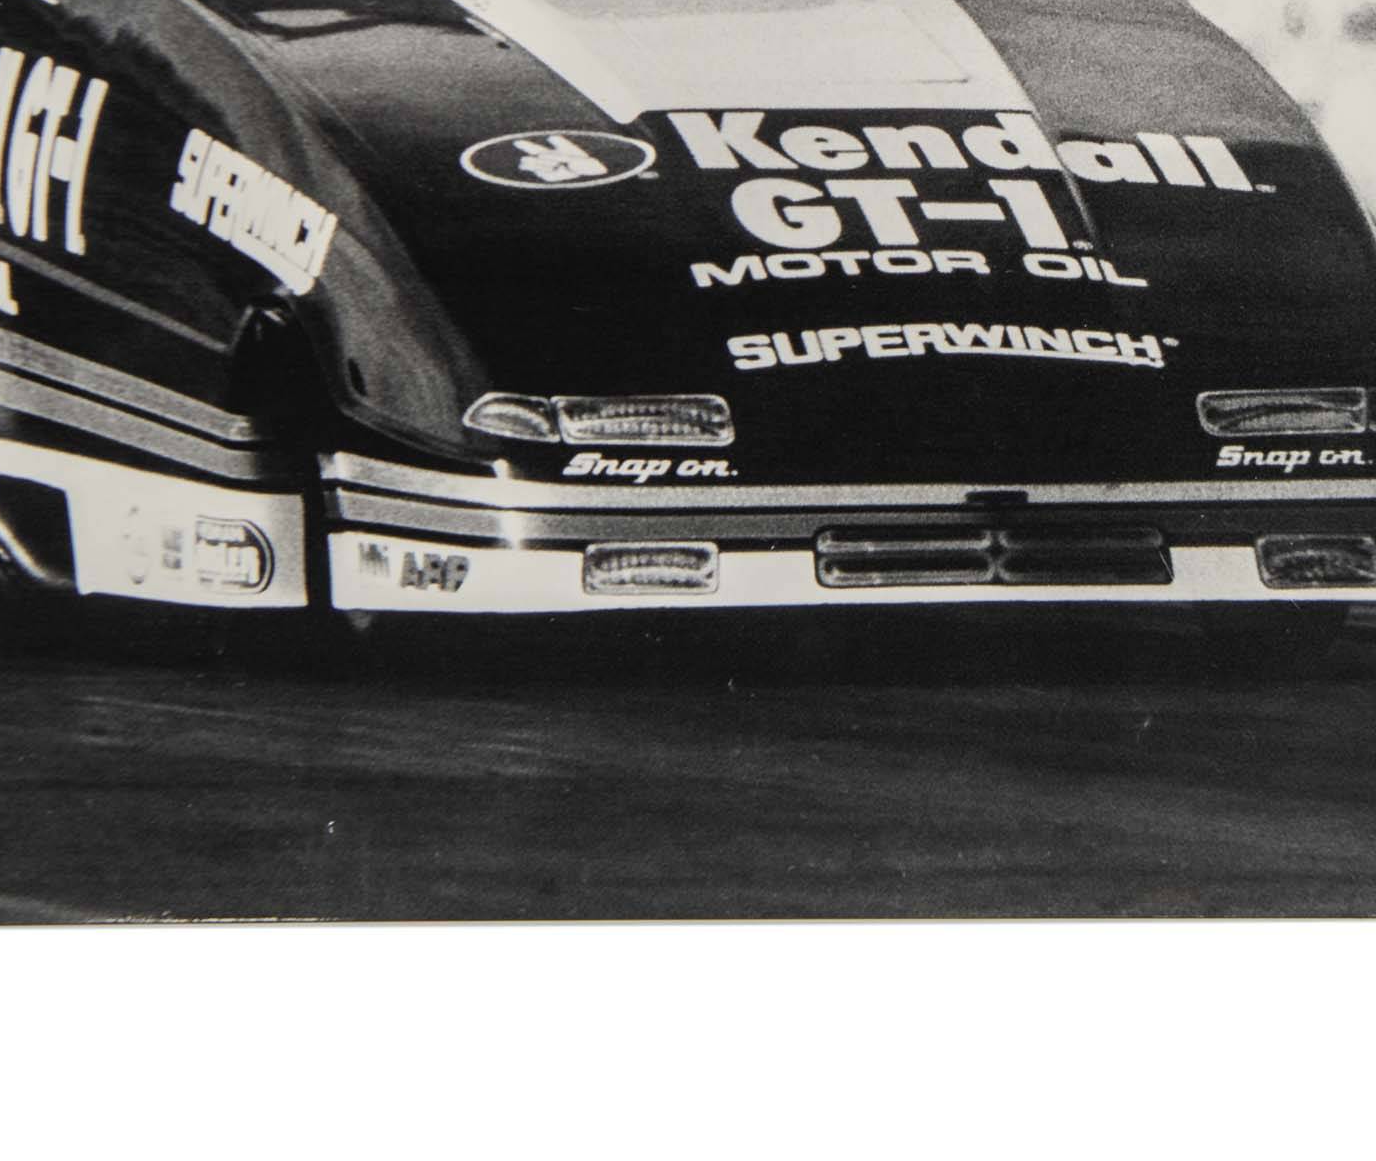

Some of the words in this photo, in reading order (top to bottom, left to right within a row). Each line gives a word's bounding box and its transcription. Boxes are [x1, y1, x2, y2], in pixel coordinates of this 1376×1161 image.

[667, 112, 1255, 192] Kendall
[731, 177, 1069, 250] GT-1
[690, 249, 991, 288] MOTOR
[1024, 253, 1149, 288] OIL
[727, 323, 1166, 370] SUPERWINCH
[562, 442, 672, 484] Snap
[1215, 444, 1312, 474] Snap
